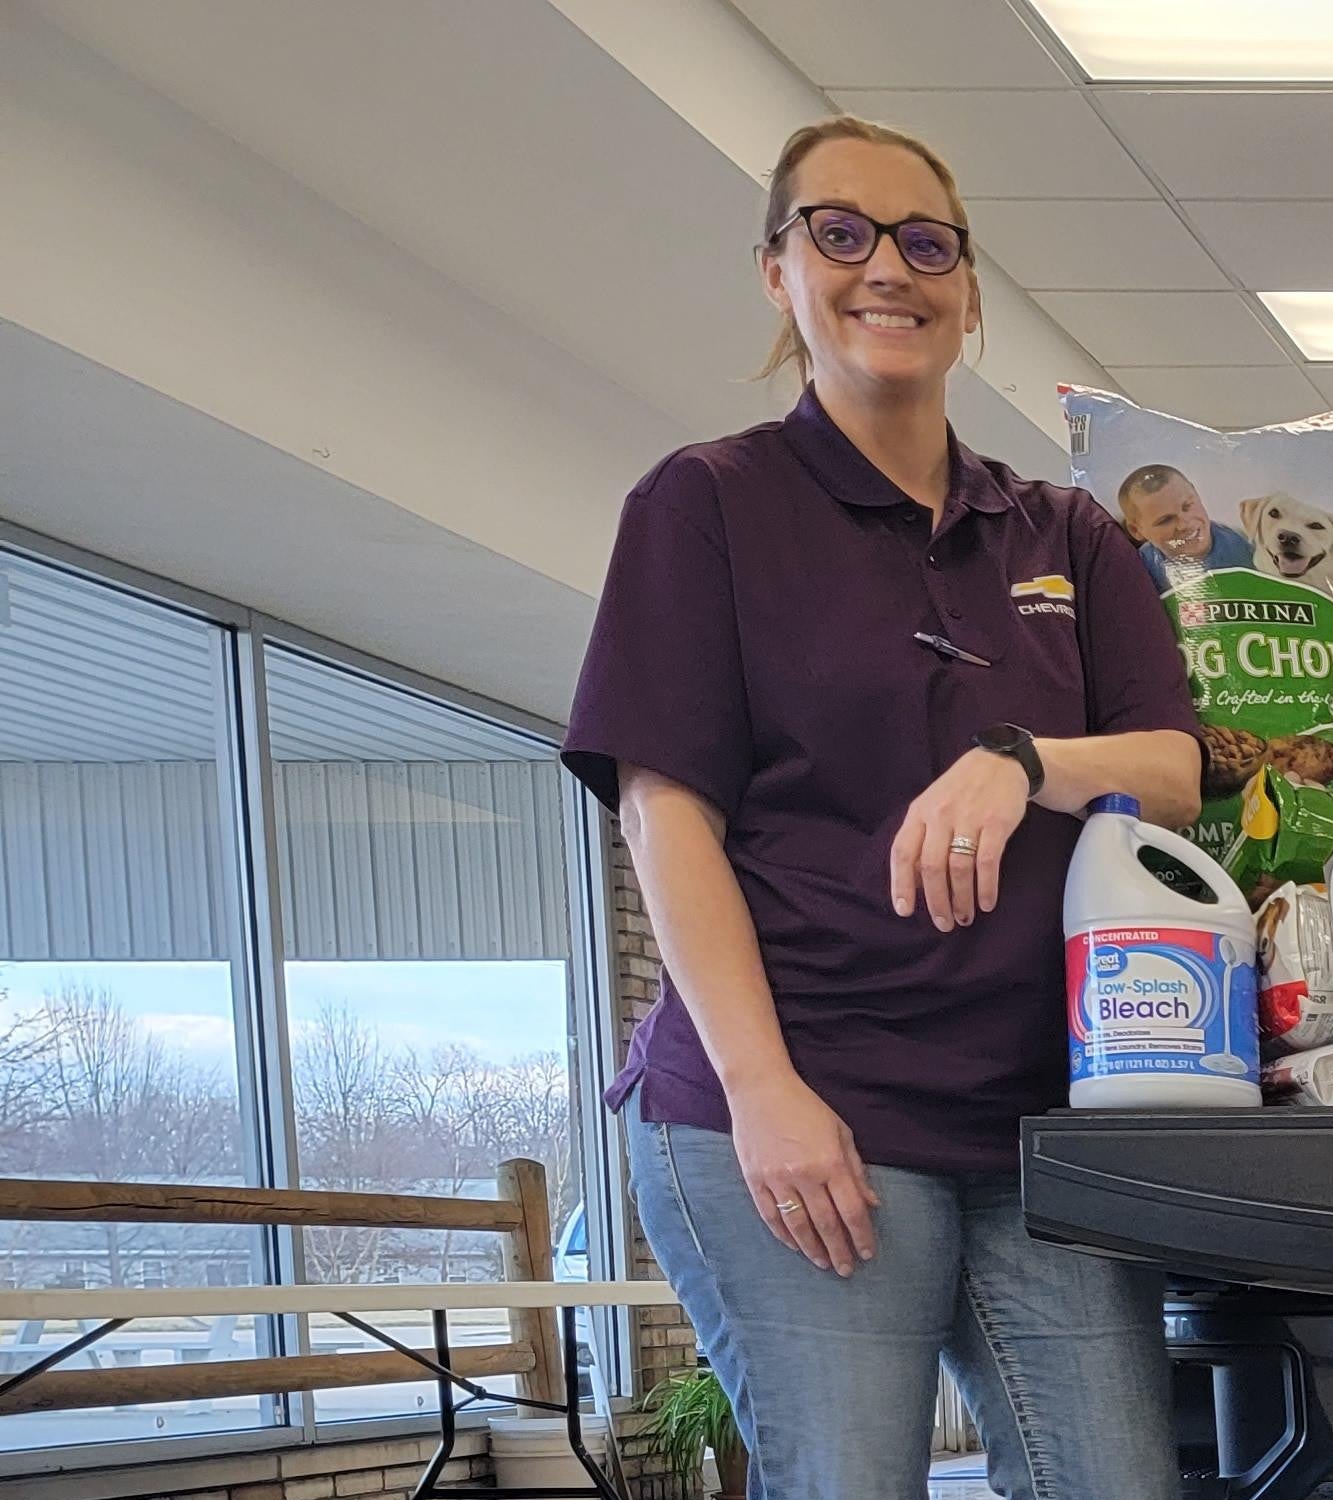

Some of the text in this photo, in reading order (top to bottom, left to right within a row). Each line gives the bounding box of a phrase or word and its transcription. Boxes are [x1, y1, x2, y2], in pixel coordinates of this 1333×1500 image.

[1209, 606, 1310, 623] PURINA
[1217, 689, 1273, 715] Crafted
[1274, 691, 1294, 704] in
[1097, 979, 1189, 996] Low-Splash
[1099, 997, 1190, 1020] Bleach
